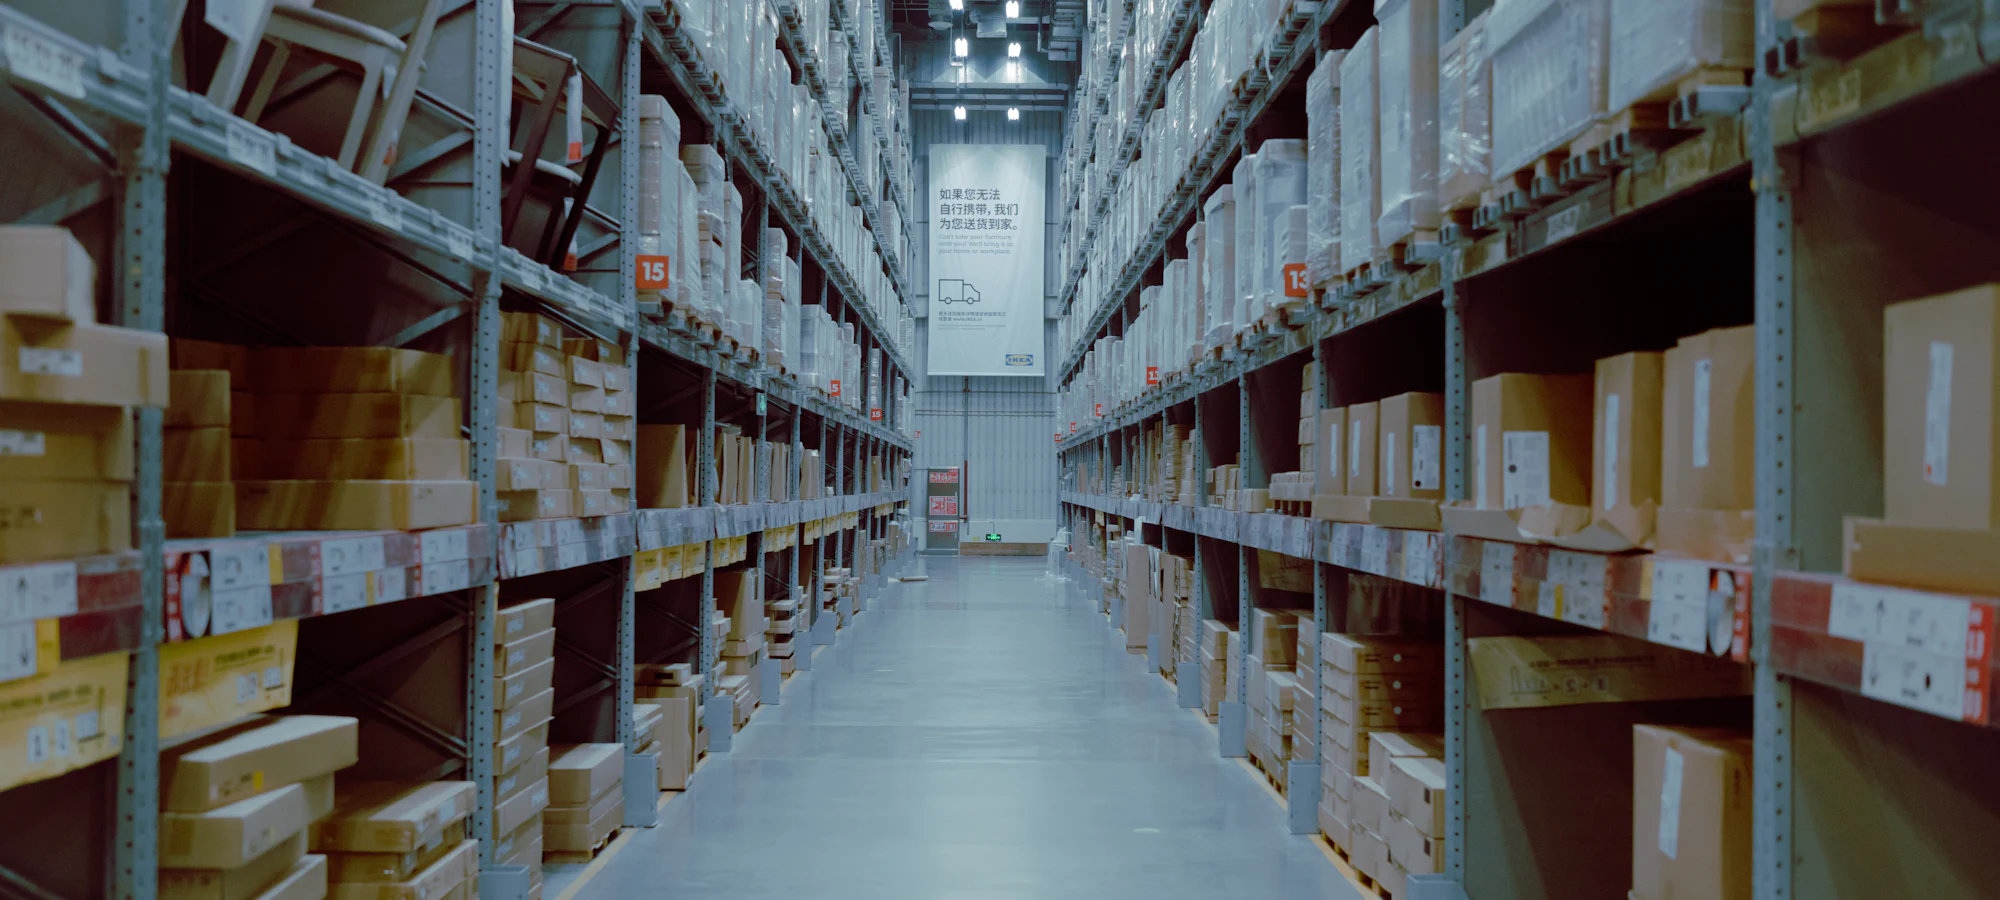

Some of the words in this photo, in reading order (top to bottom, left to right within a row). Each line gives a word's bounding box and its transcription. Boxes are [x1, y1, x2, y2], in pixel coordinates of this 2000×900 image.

[940, 188, 1000, 201] 如果您无法
[939, 218, 1017, 230] 为您送货到家。
[642, 262, 665, 281] 15
[1289, 270, 1308, 289] 13
